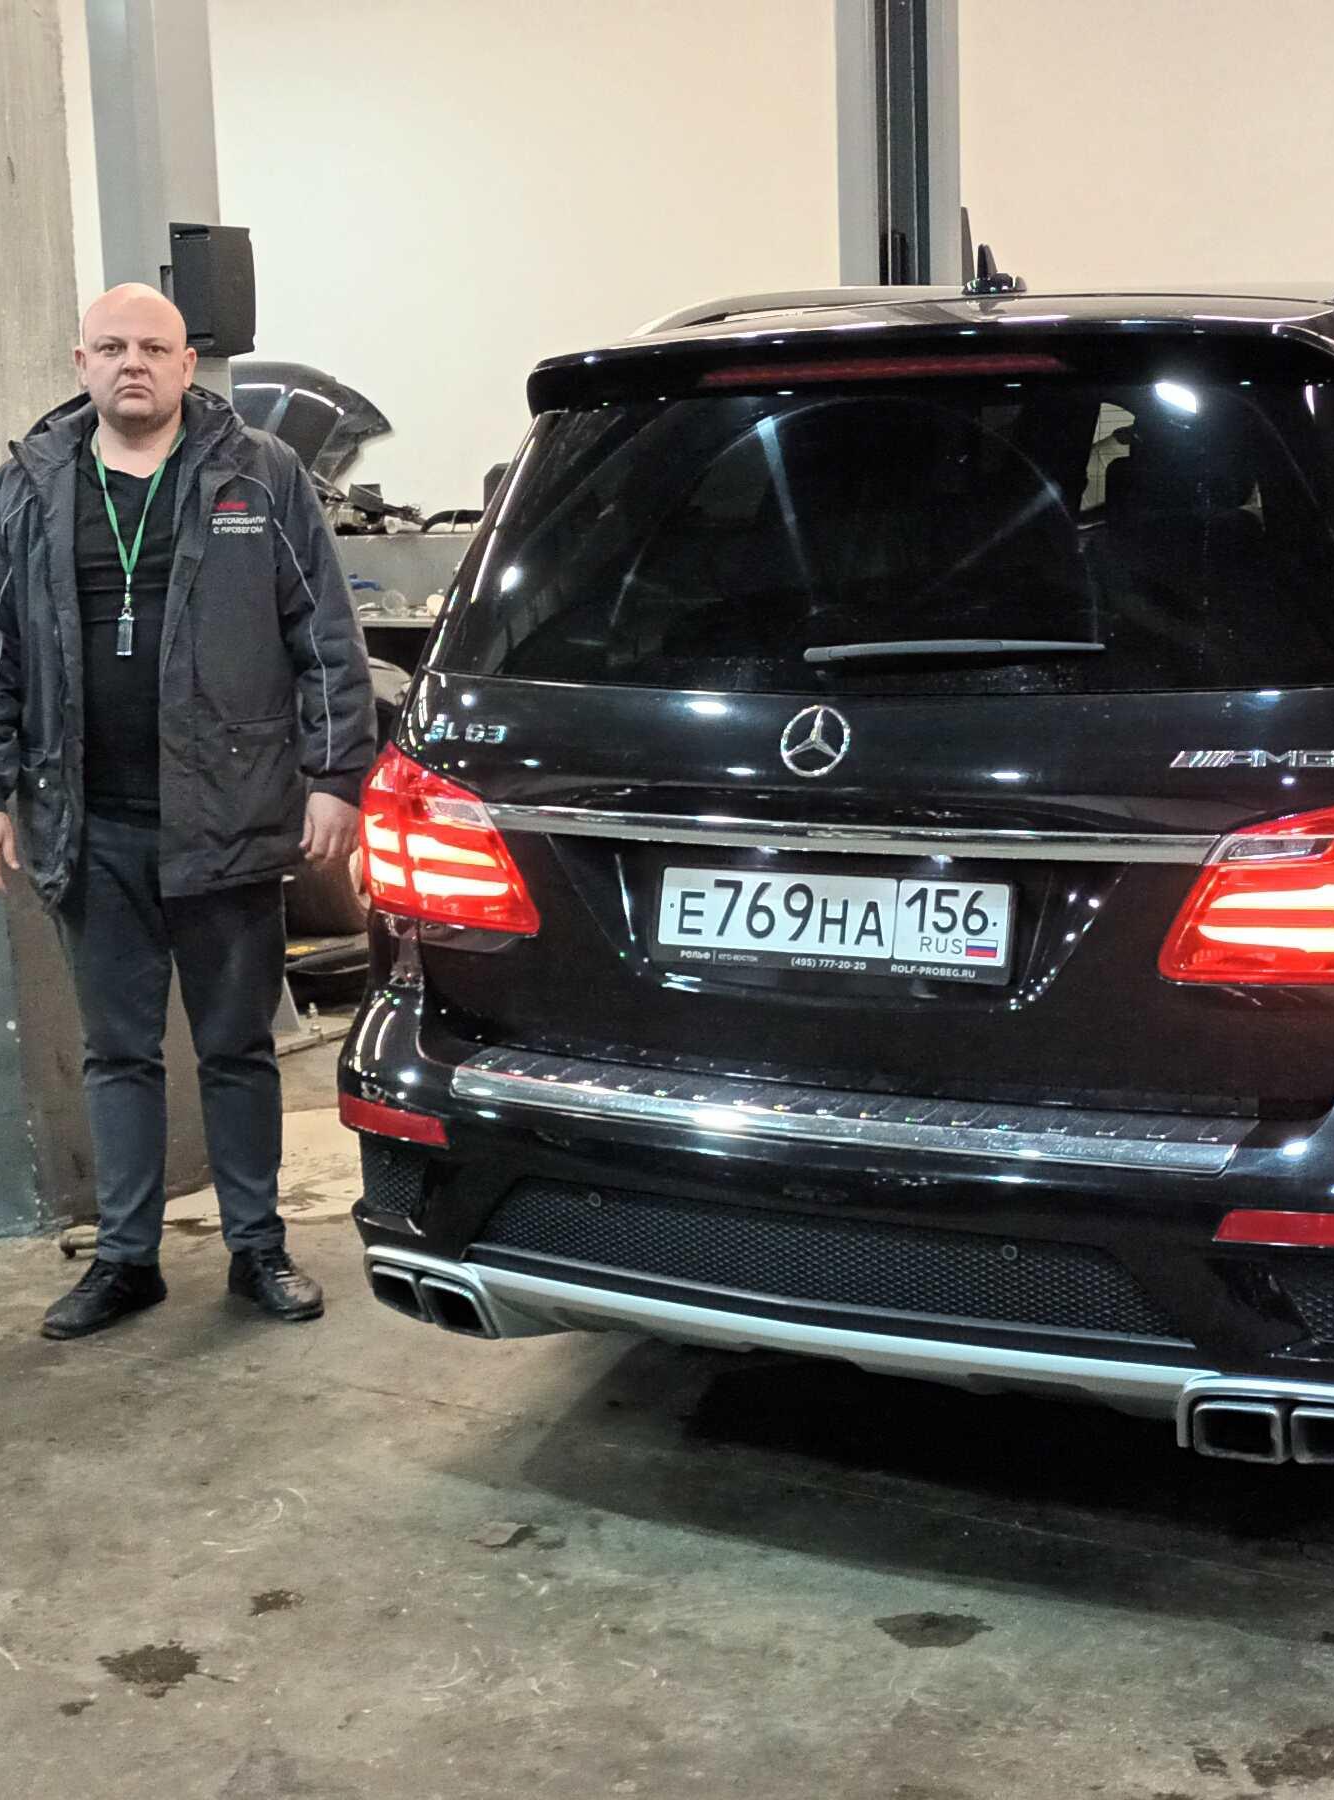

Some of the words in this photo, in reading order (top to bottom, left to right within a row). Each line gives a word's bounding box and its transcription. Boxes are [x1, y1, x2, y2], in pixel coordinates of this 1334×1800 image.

[465, 723, 507, 744] 63
[677, 879, 885, 947] Е769НА
[904, 887, 989, 937] 156
[919, 936, 963, 954] RUS
[680, 950, 711, 960] РОЛЬФ
[790, 957, 816, 969] (495)
[818, 958, 867, 970] 777-20-20
[890, 963, 976, 979] ROLF-PROBEG.RU
